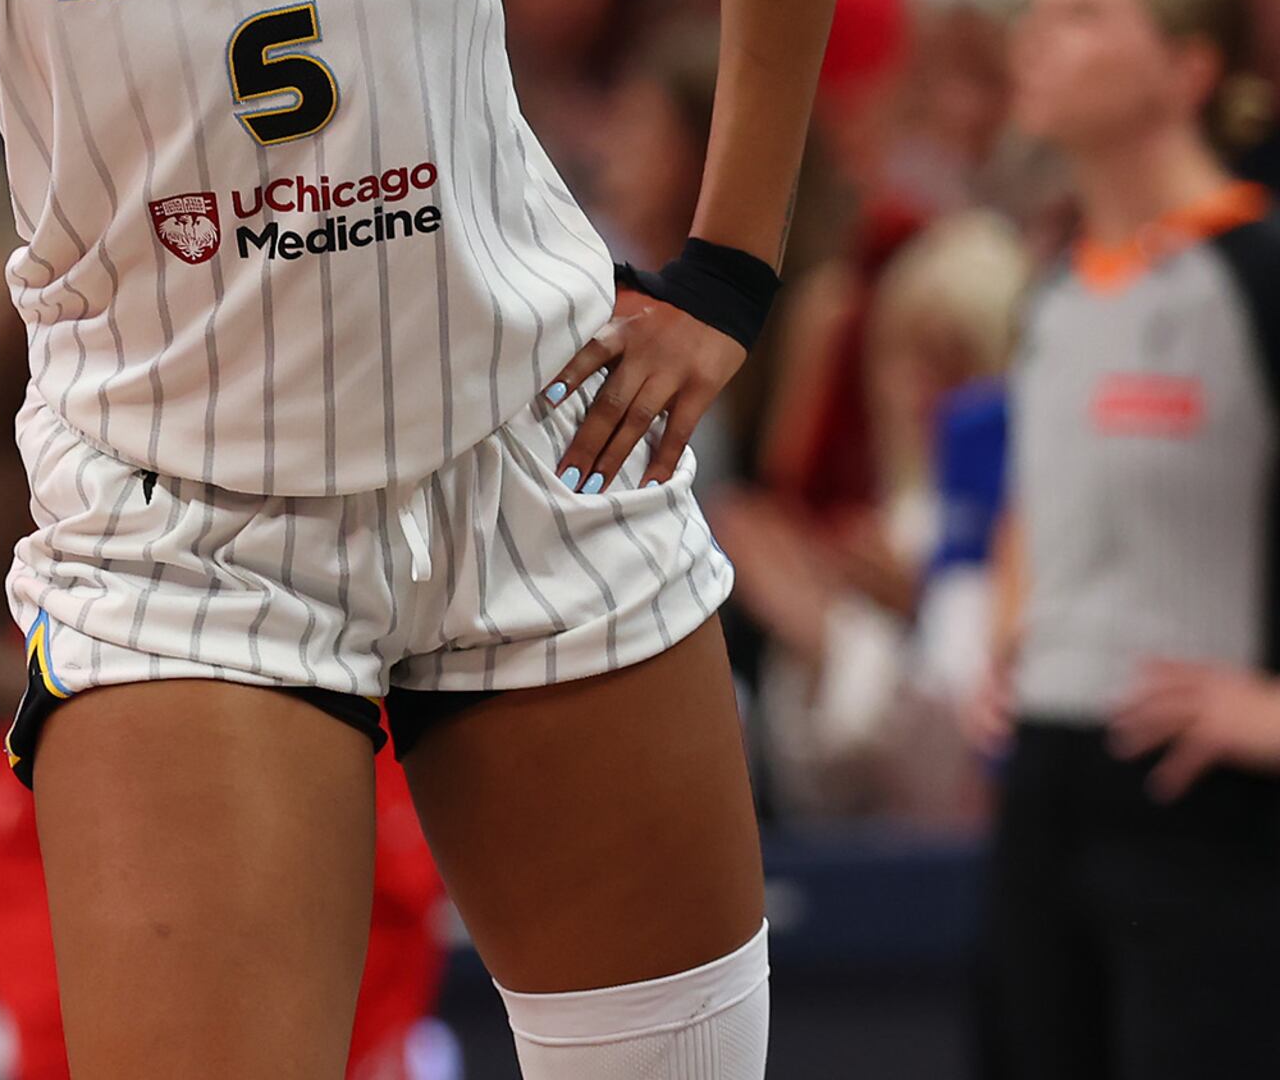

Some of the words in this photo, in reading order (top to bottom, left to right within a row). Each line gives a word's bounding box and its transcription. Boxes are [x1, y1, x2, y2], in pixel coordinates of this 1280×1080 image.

[225, 0, 341, 148] 5
[231, 162, 438, 220] UChicago
[235, 205, 441, 261] Medicine
